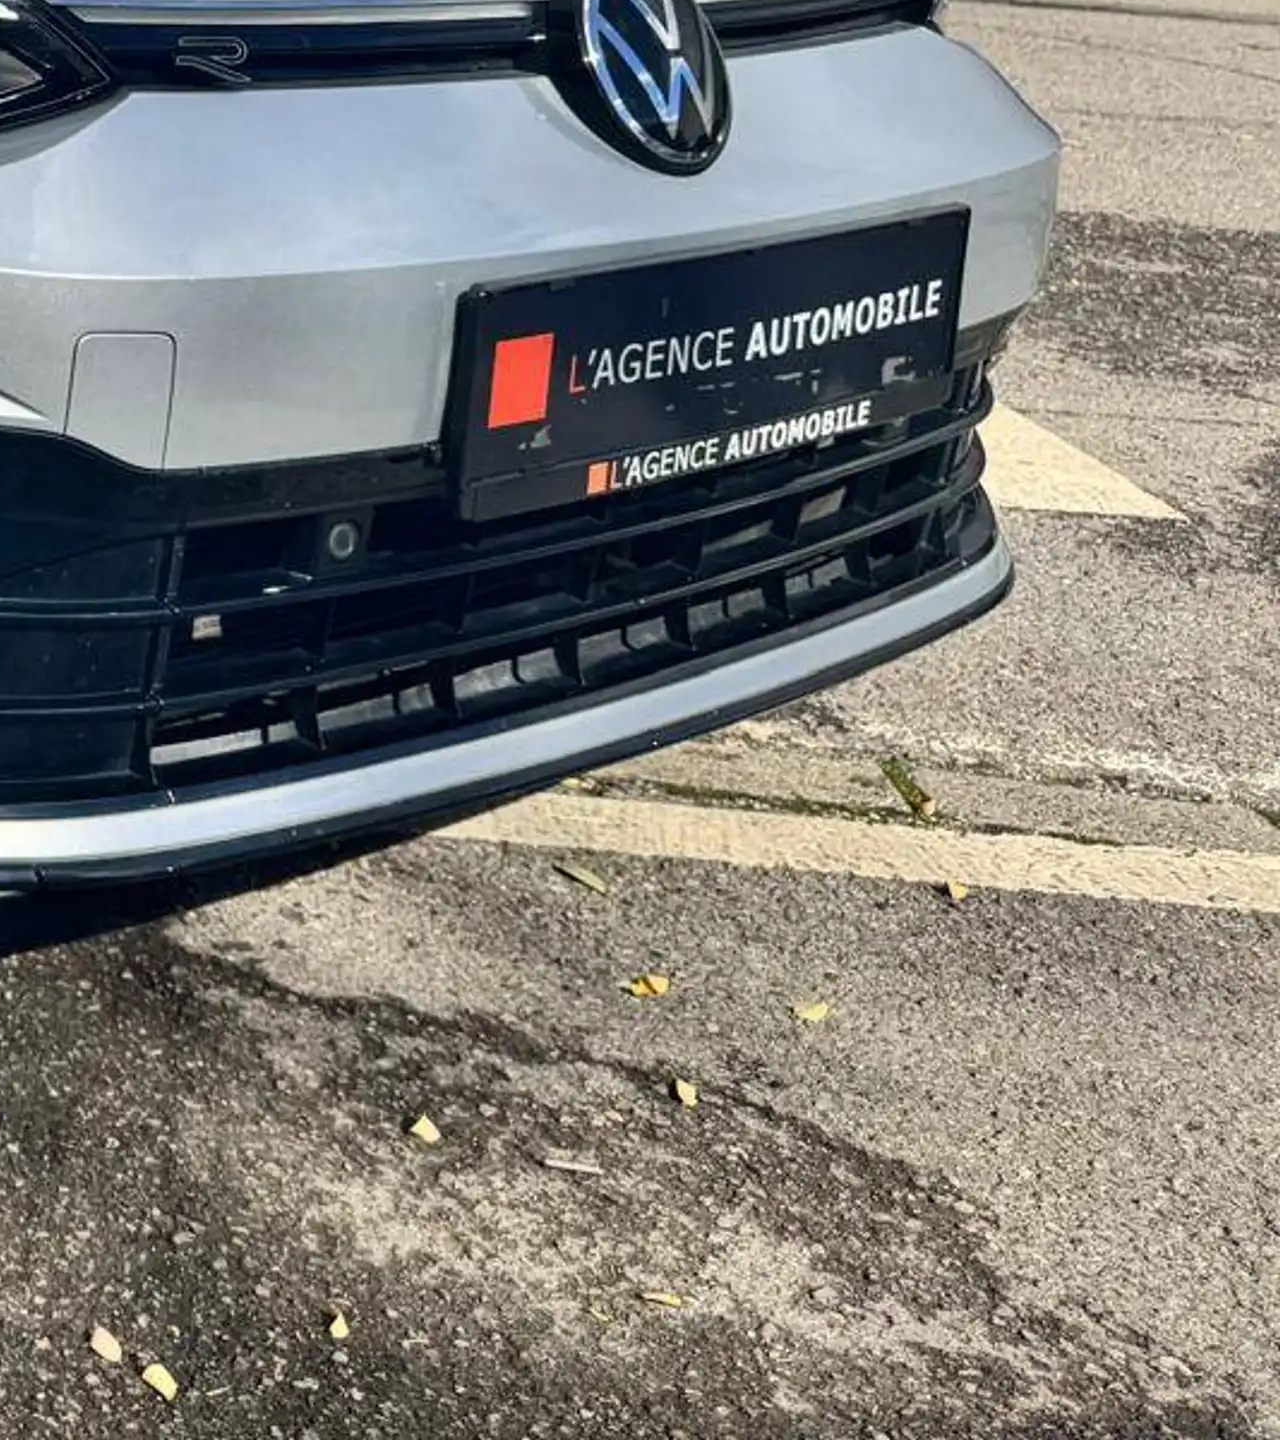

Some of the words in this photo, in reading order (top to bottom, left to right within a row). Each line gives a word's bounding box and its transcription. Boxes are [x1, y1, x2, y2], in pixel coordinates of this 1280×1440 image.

[568, 326, 736, 395] L'AGENCE
[744, 278, 943, 361] AUTOMOBILE
[609, 437, 720, 490] L'AGENCE
[725, 400, 872, 460] AUTOMOBILE
